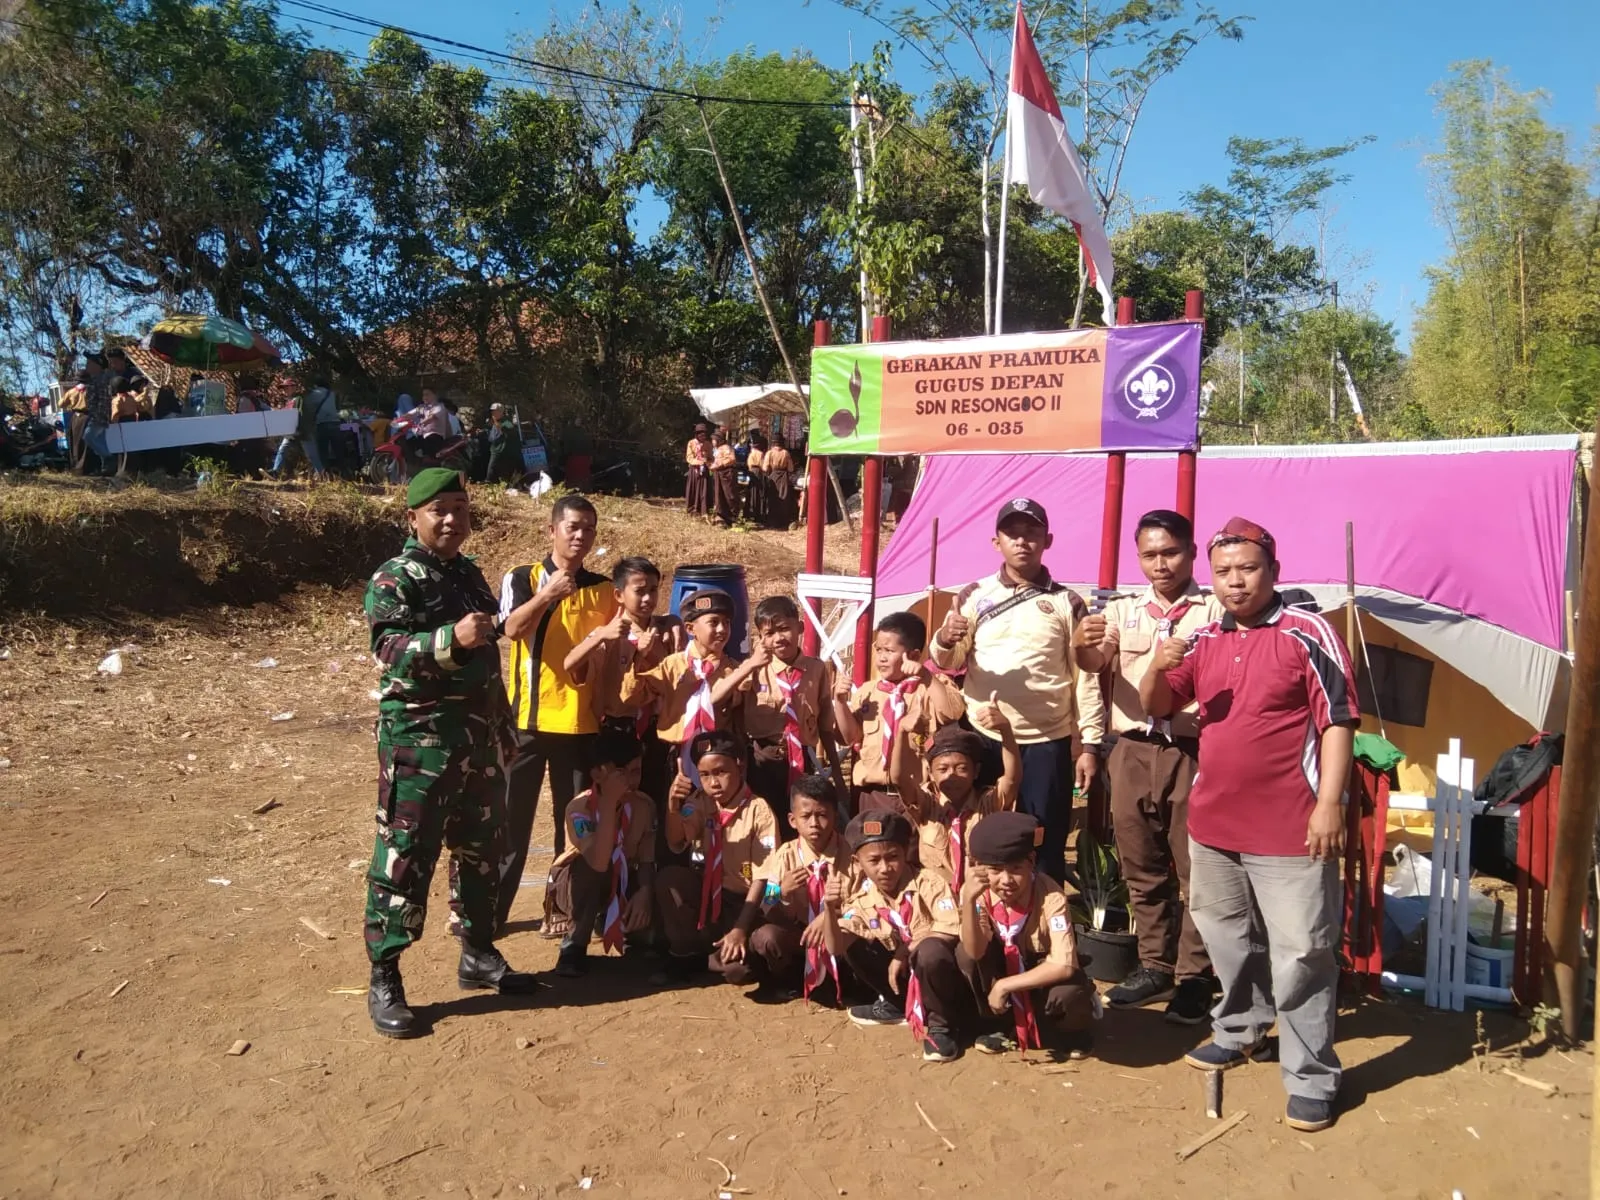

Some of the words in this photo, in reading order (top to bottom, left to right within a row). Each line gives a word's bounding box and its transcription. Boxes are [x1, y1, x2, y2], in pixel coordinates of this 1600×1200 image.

[887, 354, 983, 374] GERAKAN
[989, 348, 1100, 369] PRAMUKA
[915, 376, 985, 394] GUGUS
[991, 373, 1064, 391] DEPAN
[915, 399, 947, 415] SDN
[945, 423, 968, 436] 06
[988, 421, 1024, 436] 035
